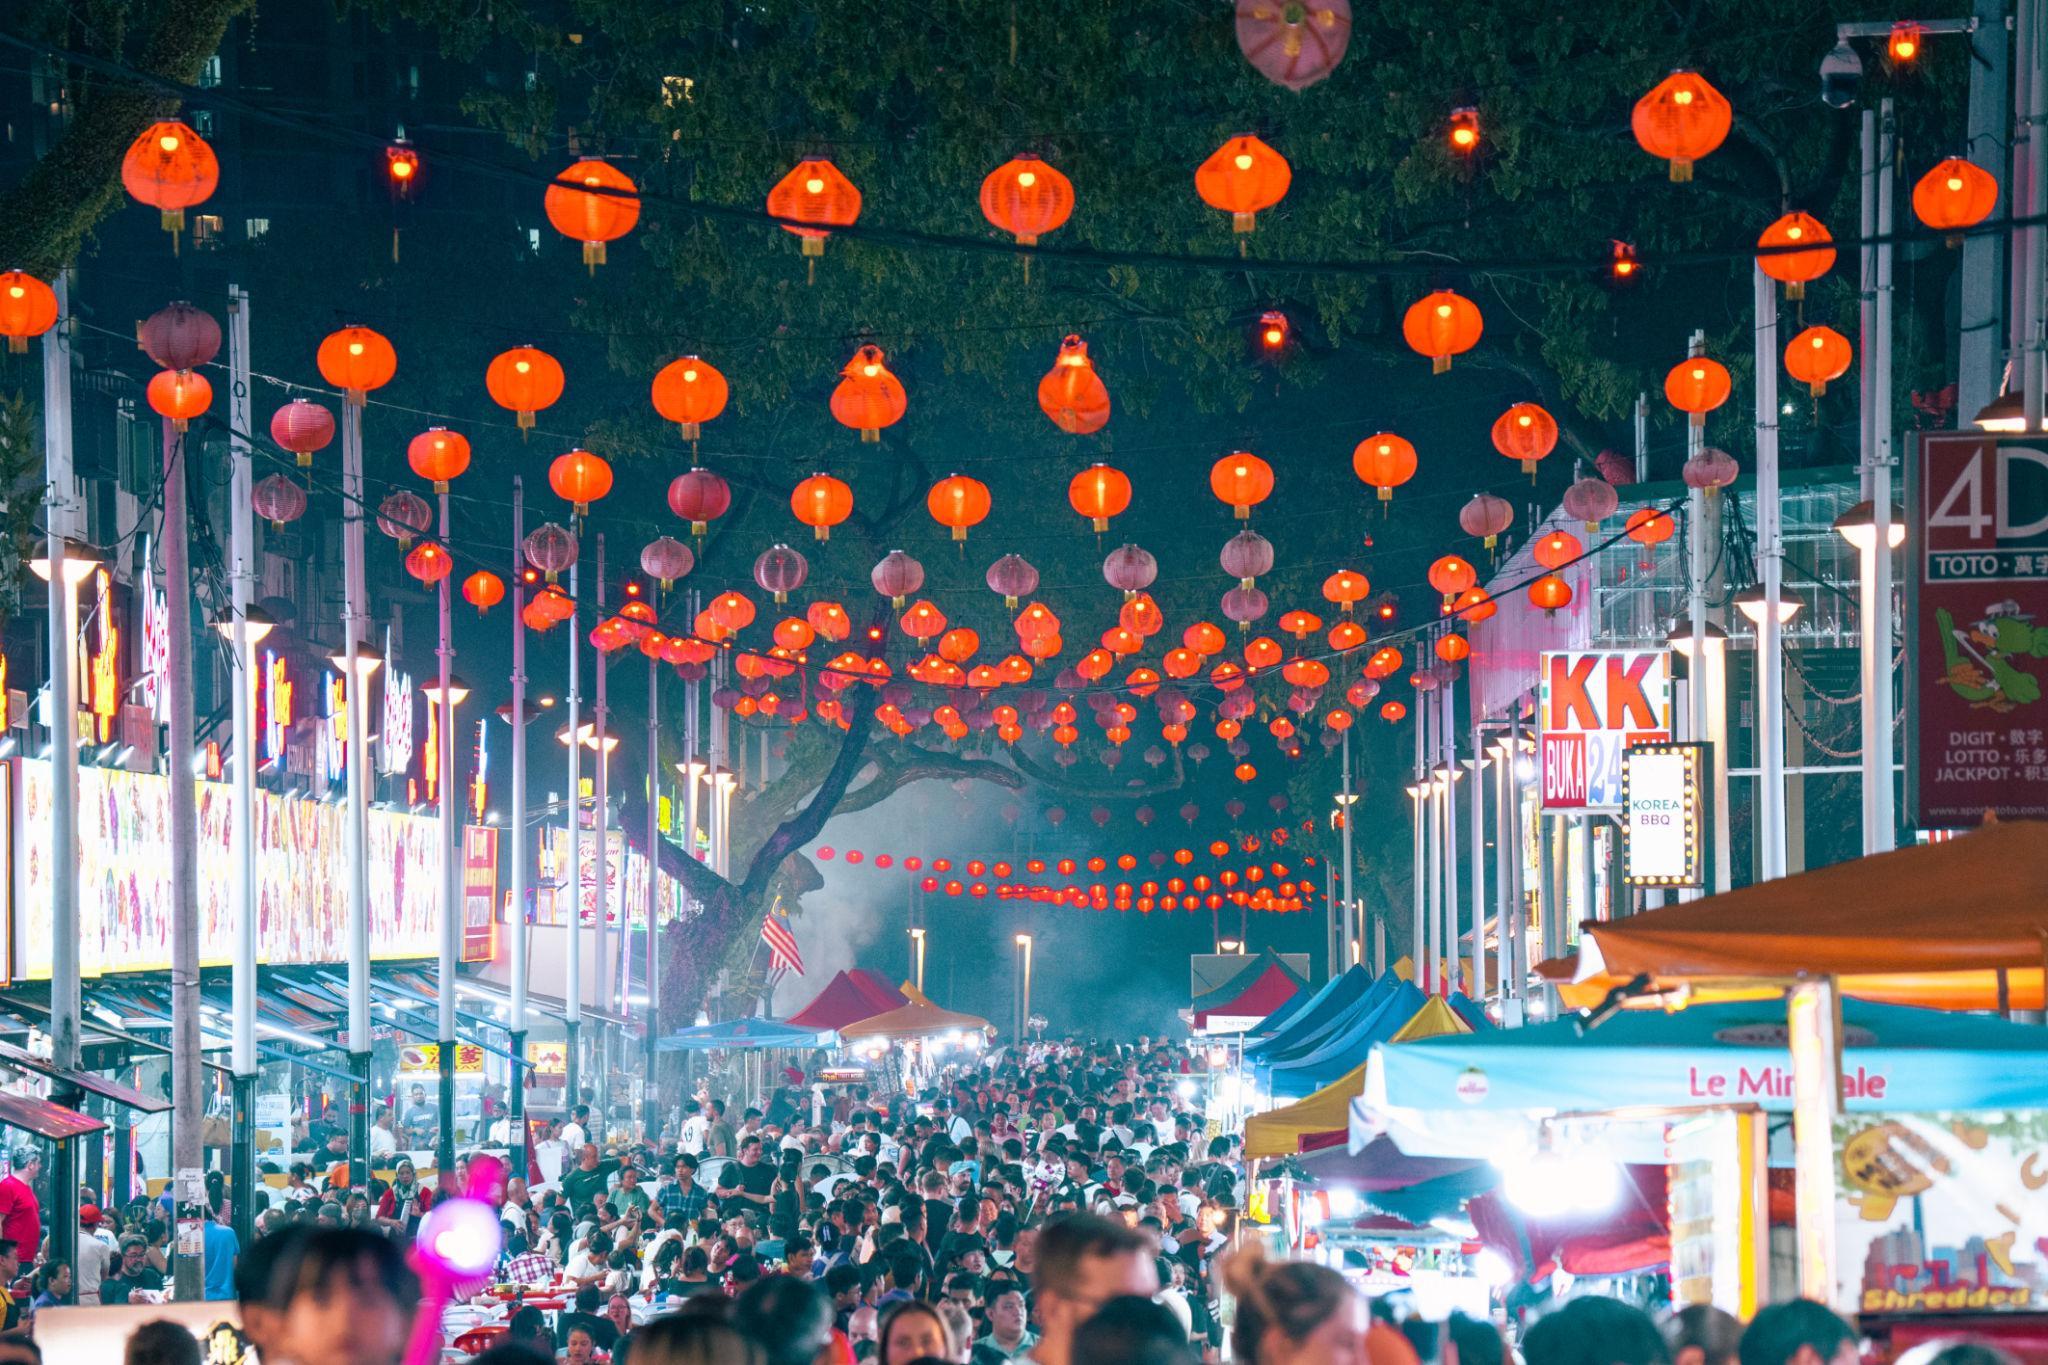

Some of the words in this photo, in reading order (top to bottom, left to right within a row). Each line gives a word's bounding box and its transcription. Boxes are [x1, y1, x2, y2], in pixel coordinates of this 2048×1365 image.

[1928, 445, 2048, 540] 4D
[1935, 555, 1998, 576] TOTO
[1551, 654, 1659, 730] KK
[1949, 731, 1996, 747] DIGIT
[2009, 728, 2043, 746] 数字
[1945, 749, 2000, 764] LOTTO
[1547, 739, 1585, 800] BUKA
[1588, 735, 1623, 804] 24
[1935, 766, 2010, 782] JACKPOT
[1632, 799, 1680, 811] KOREA
[1641, 814, 1670, 825] BBQ
[1690, 1066, 1726, 1097] Le
[1863, 1286, 2031, 1312] Shredded
